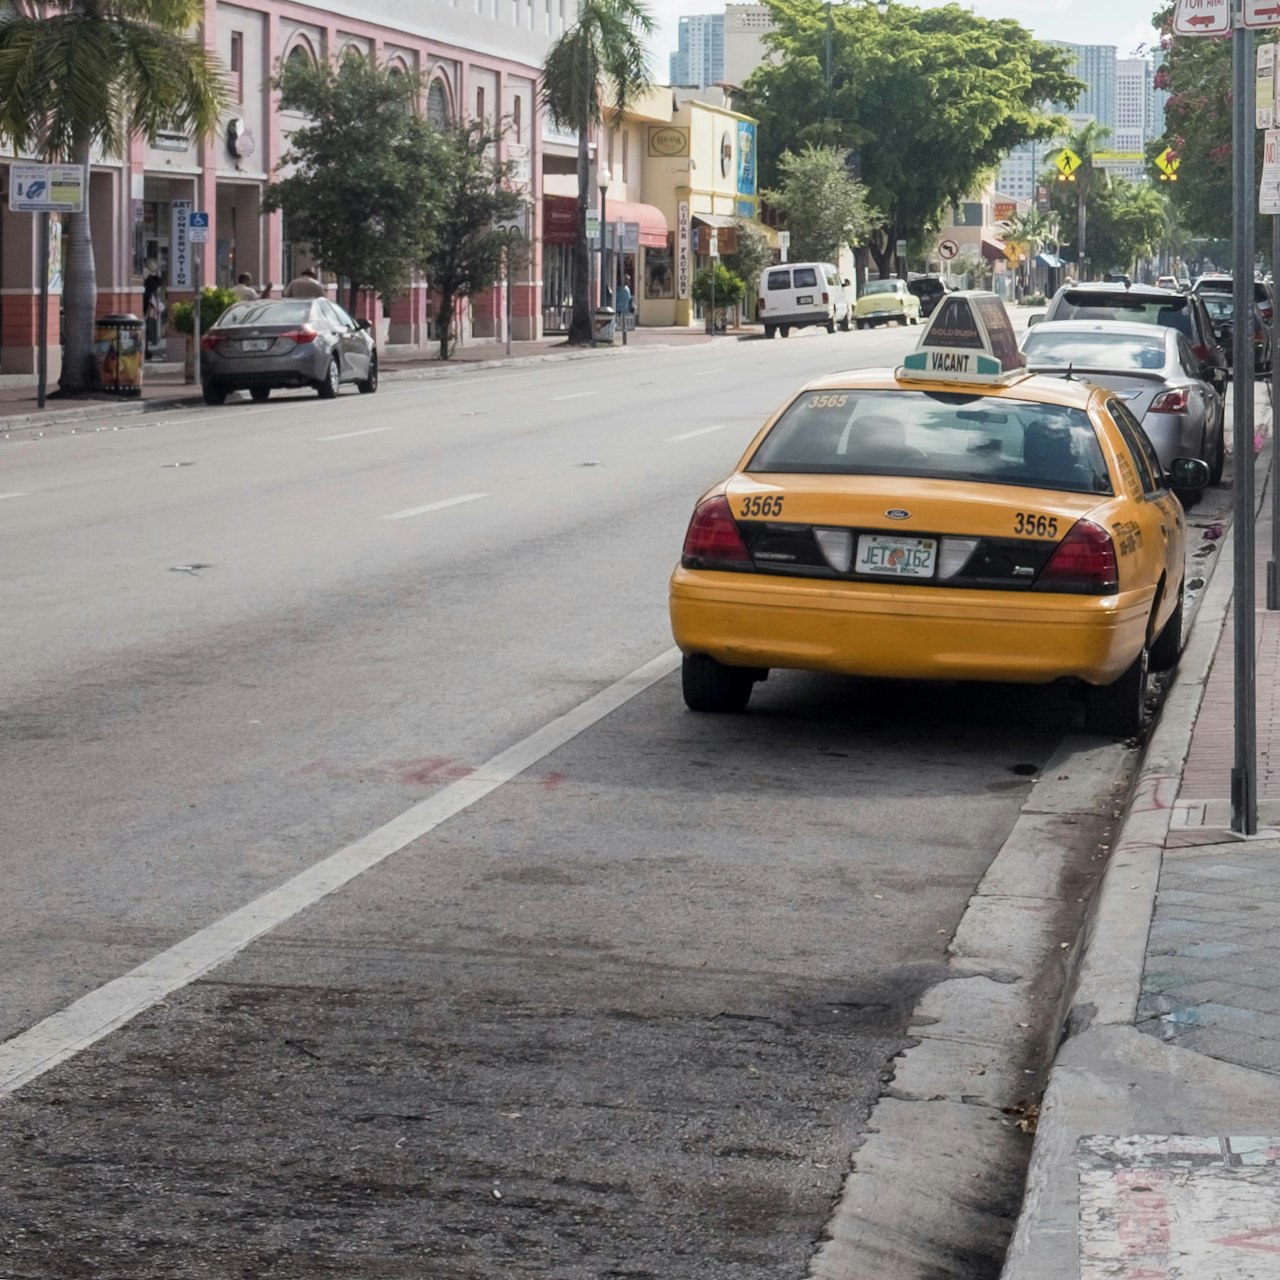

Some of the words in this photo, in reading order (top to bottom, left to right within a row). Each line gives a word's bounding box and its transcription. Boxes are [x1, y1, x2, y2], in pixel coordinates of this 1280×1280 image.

[1266, 142, 1276, 164] NO
[177, 209, 187, 285] CONSERVATION
[680, 247, 688, 295] FACTORY
[932, 352, 970, 372] VACANT
[808, 394, 849, 408] 3565
[740, 496, 785, 517] 3565
[1014, 512, 1058, 538] 3565
[861, 546, 888, 565] JET
